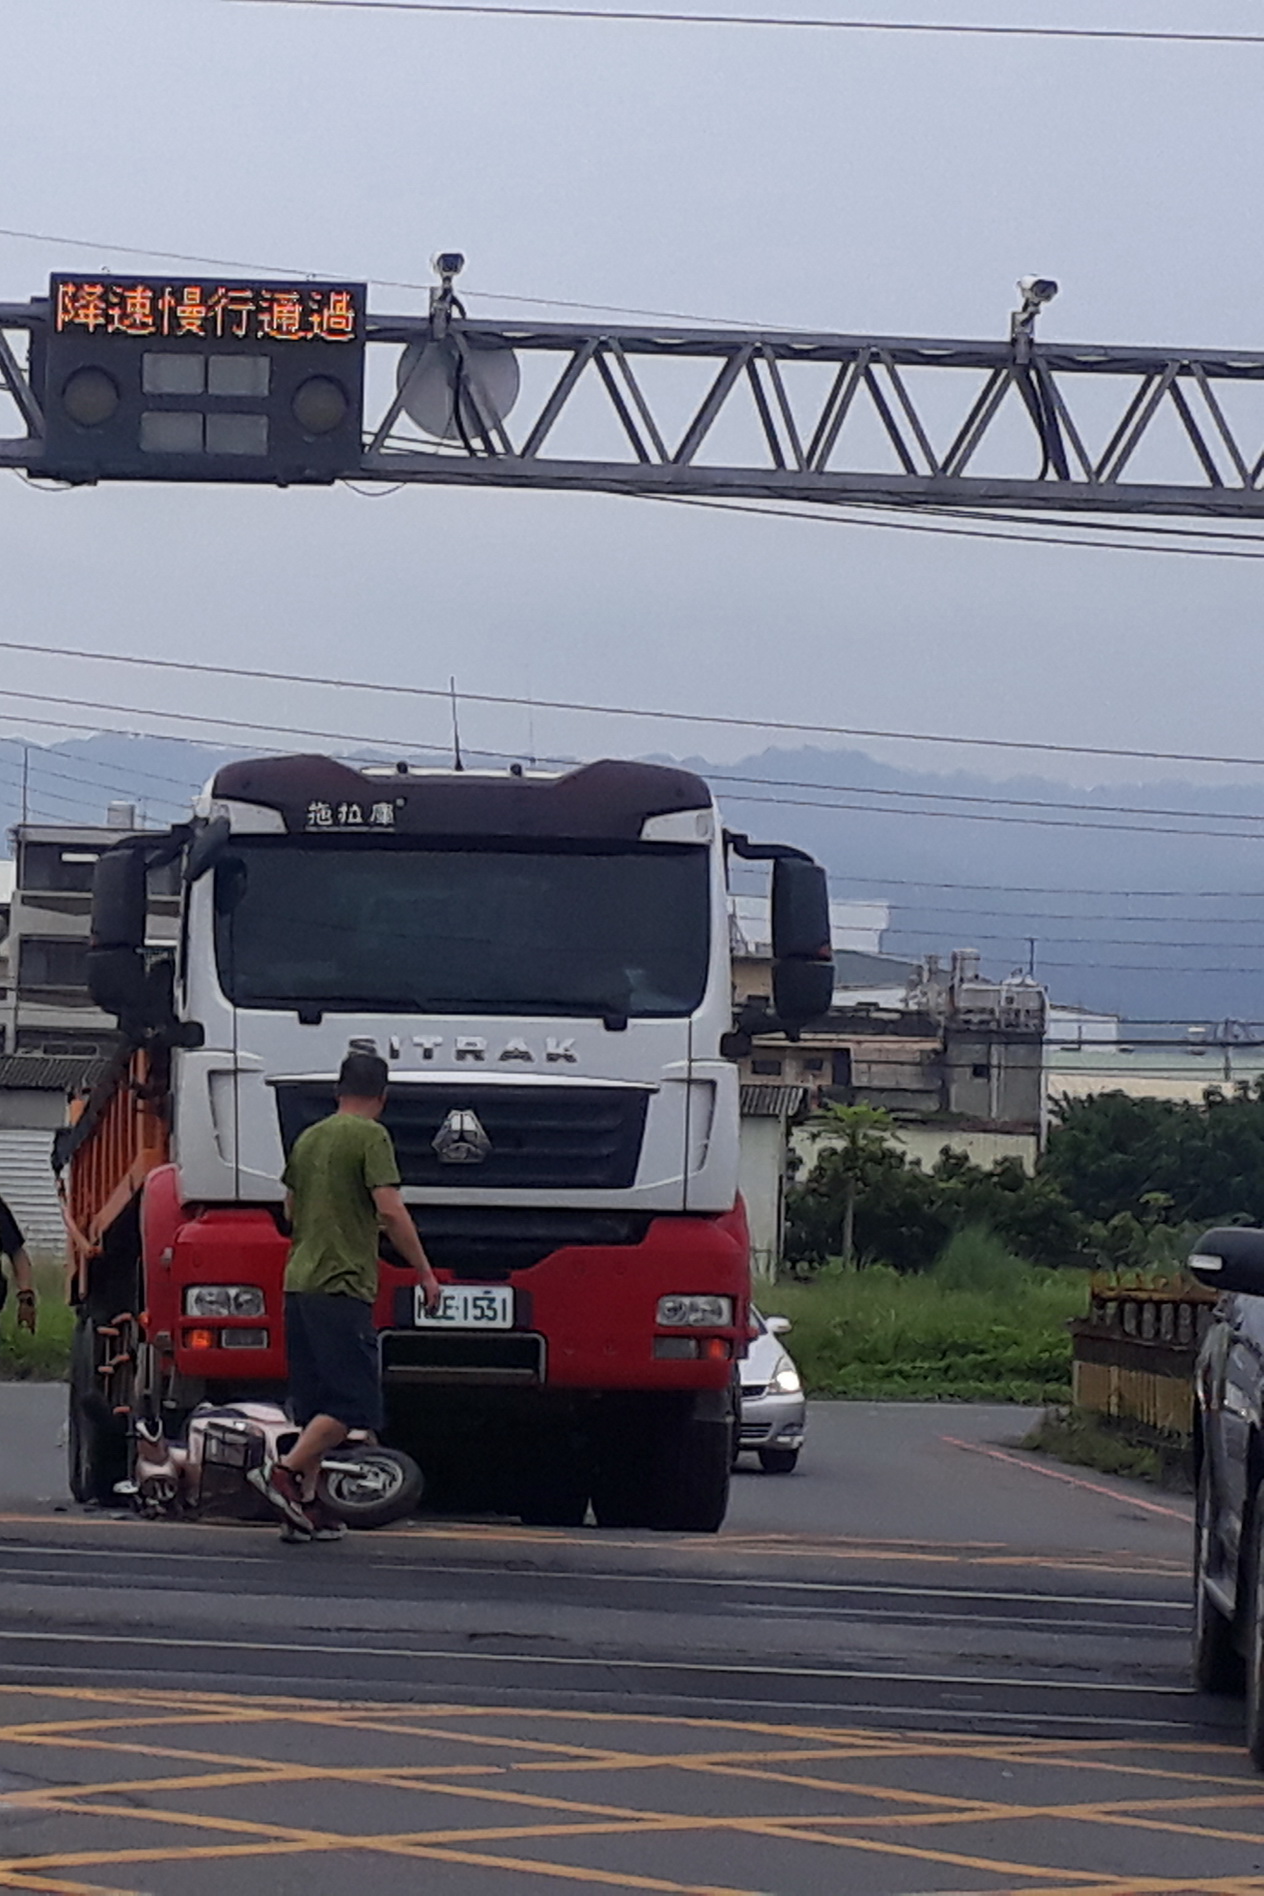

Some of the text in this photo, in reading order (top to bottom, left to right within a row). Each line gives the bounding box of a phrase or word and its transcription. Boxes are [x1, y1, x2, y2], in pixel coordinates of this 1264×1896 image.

[56, 282, 355, 341] 降速慢行通過
[417, 1295, 507, 1322] KE-1531
